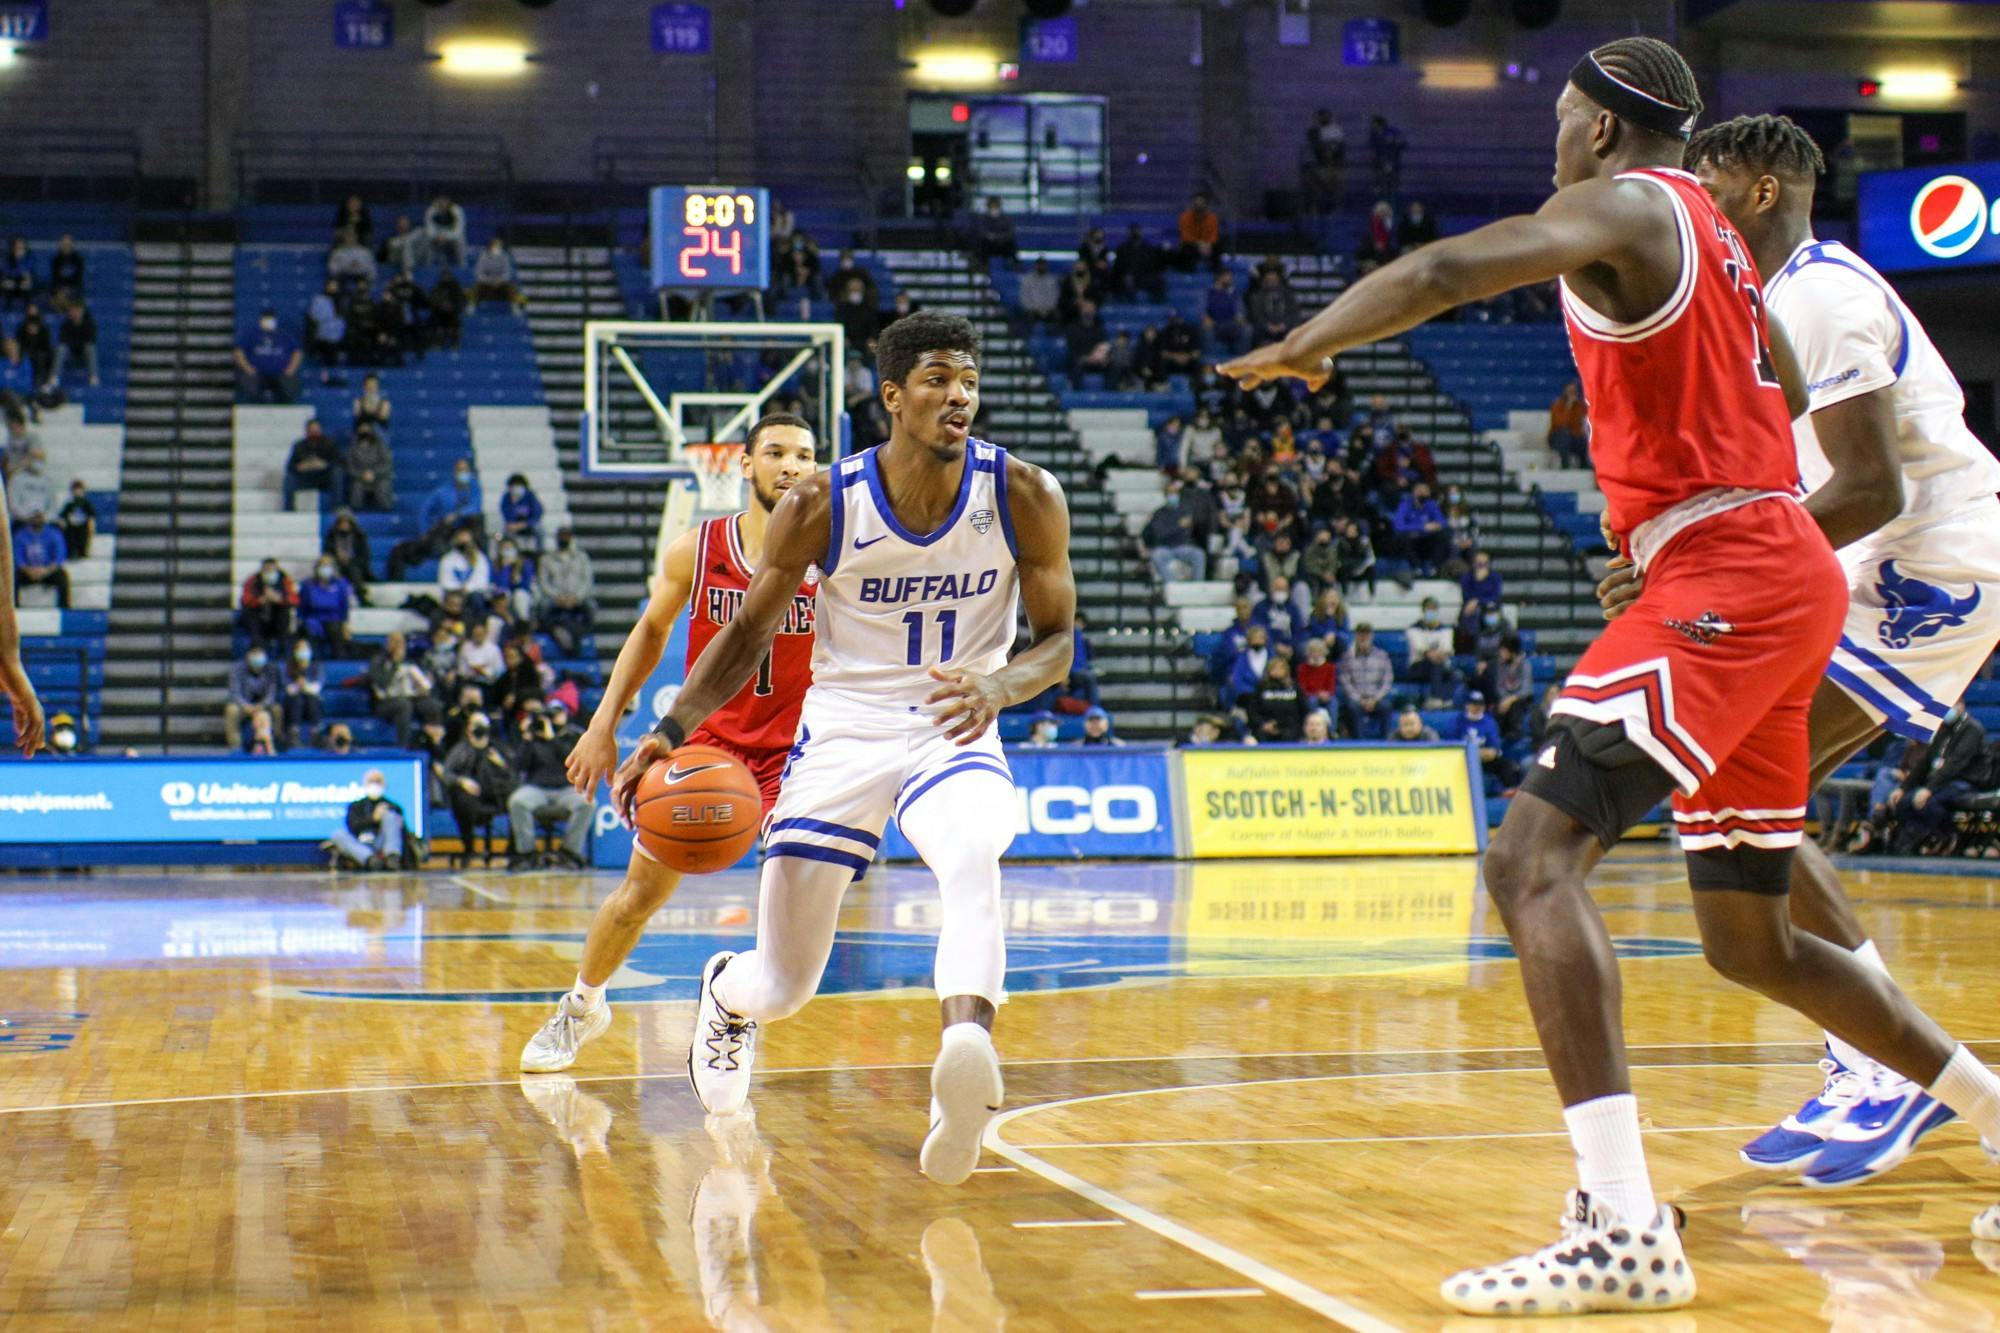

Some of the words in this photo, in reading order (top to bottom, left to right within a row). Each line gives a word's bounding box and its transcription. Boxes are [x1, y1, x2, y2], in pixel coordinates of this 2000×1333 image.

[664, 27, 699, 47] 119
[1031, 36, 1068, 56] 120
[1356, 41, 1390, 61] 121
[685, 194, 755, 227] 8:07
[680, 227, 741, 278] 24
[860, 569, 998, 603] BUFFALO
[901, 609, 957, 666] 11
[199, 781, 280, 804] United
[1206, 786, 1454, 819] SCOTCH-N-SIRLOIN
[1016, 785, 1157, 834] ICO
